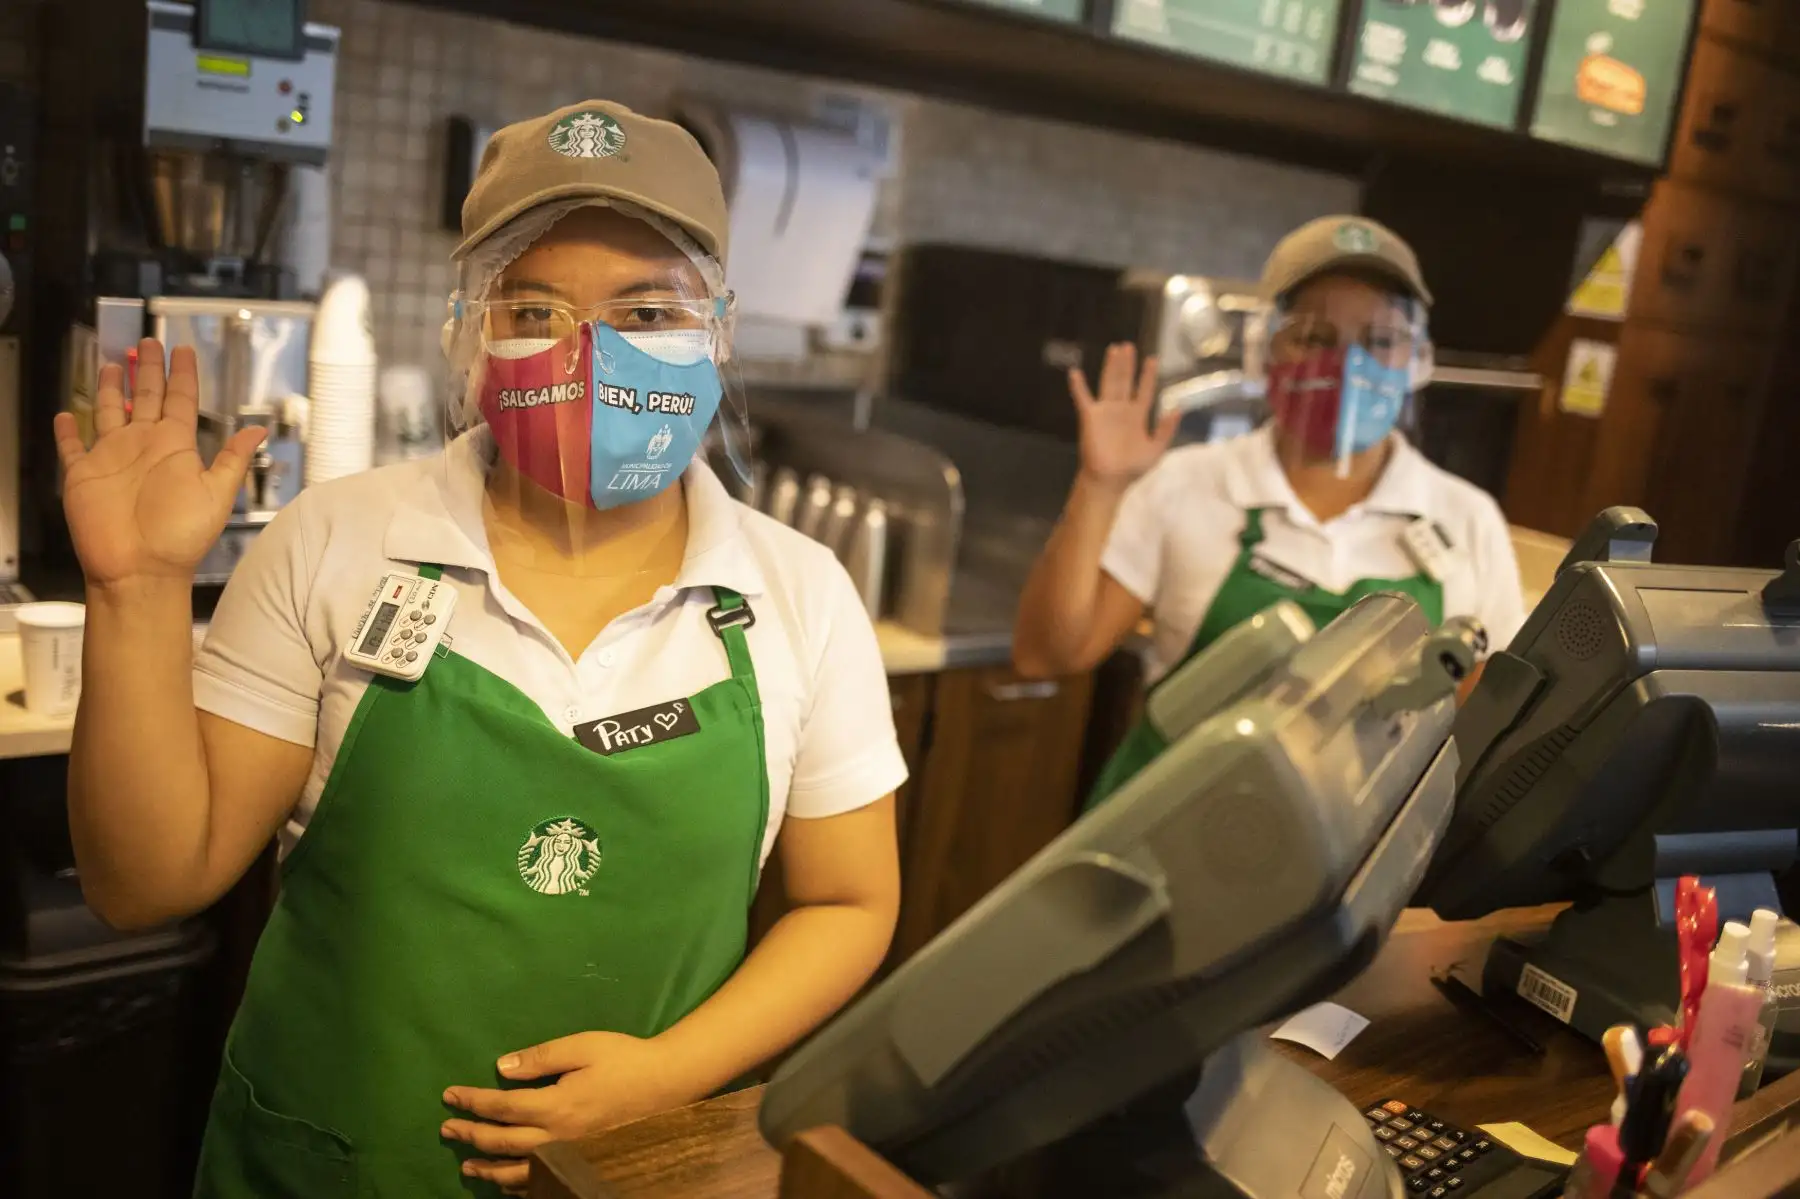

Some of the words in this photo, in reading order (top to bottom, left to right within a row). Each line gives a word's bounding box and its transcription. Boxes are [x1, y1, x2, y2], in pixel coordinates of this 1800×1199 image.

[498, 380, 586, 412] ¡SALGAMOS
[598, 381, 643, 415] BIEN,
[647, 391, 696, 416] PERÚ!
[607, 473, 662, 489] LIMA
